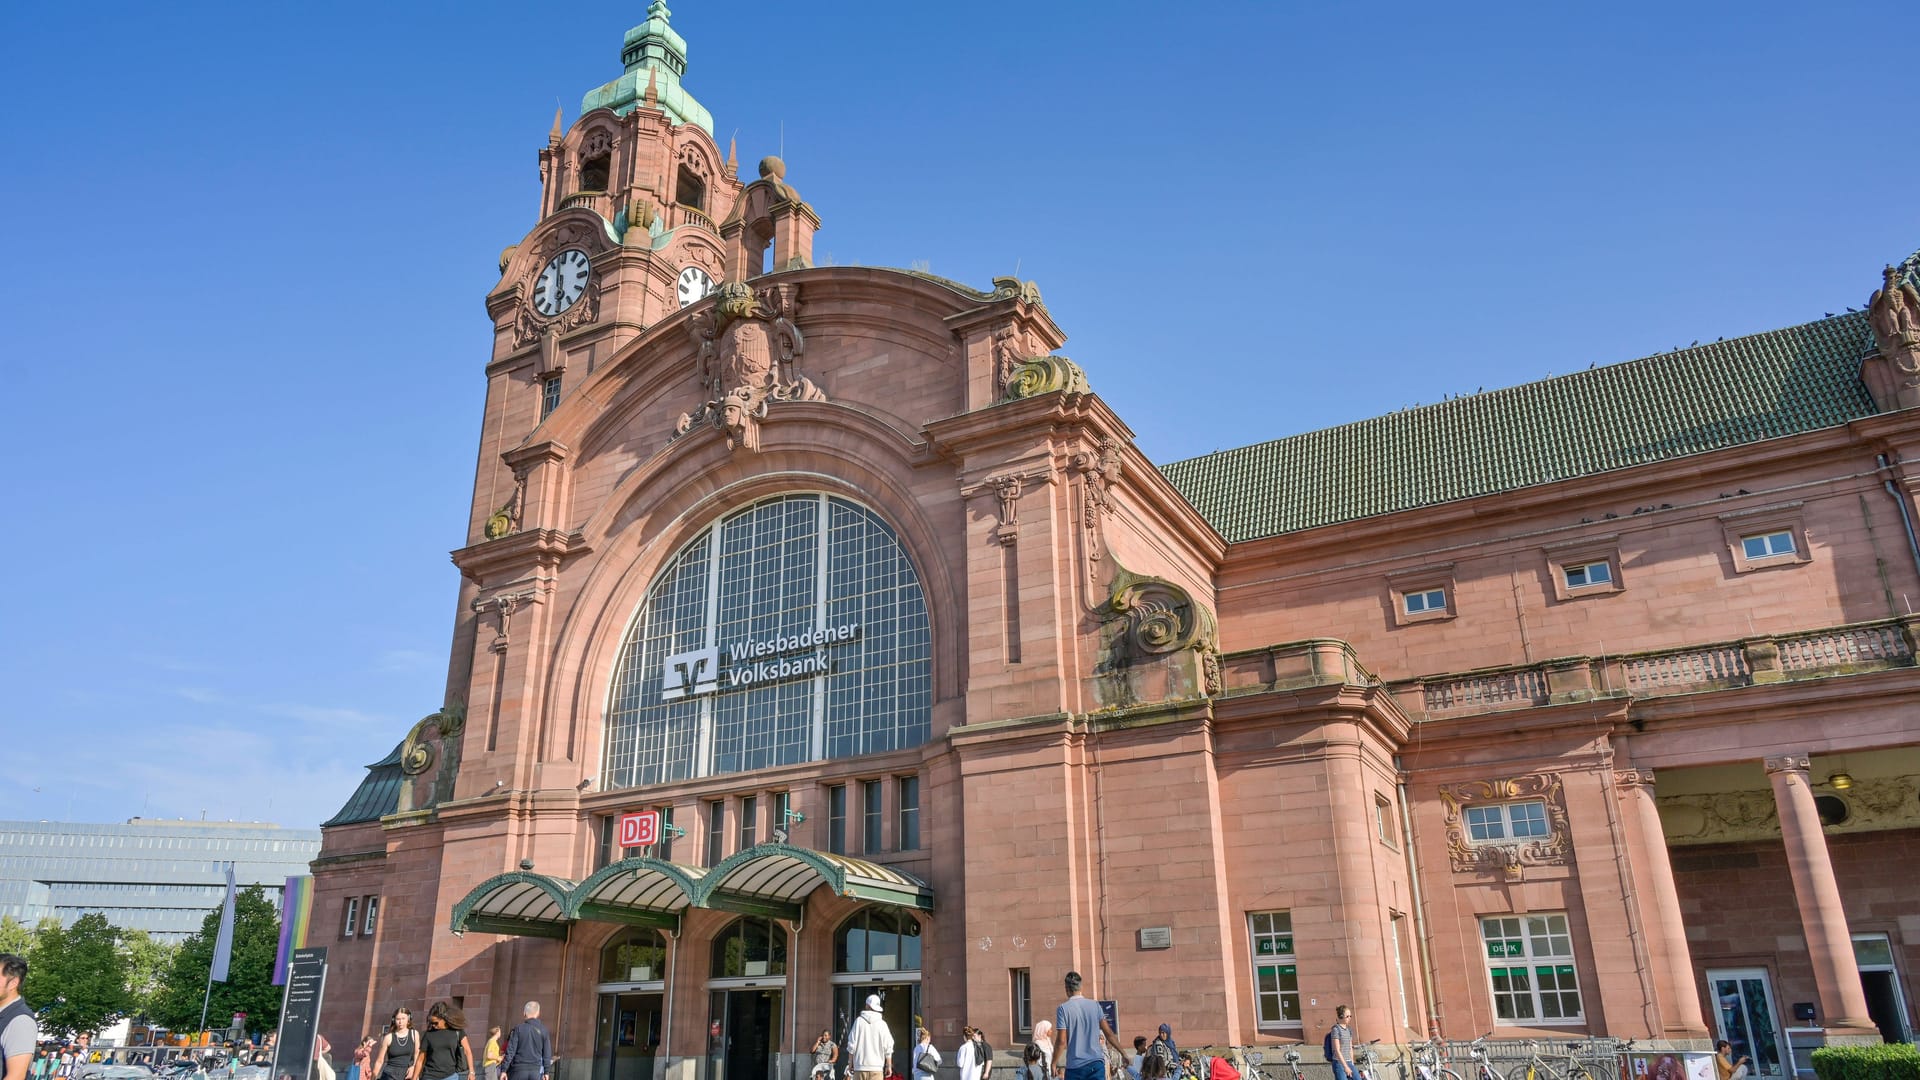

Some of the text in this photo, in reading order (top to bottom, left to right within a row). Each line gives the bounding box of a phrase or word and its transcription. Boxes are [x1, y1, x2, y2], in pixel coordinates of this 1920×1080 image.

[730, 623, 858, 661] Wiesbadener
[728, 649, 828, 686] Volksbank
[624, 817, 651, 842] DB
